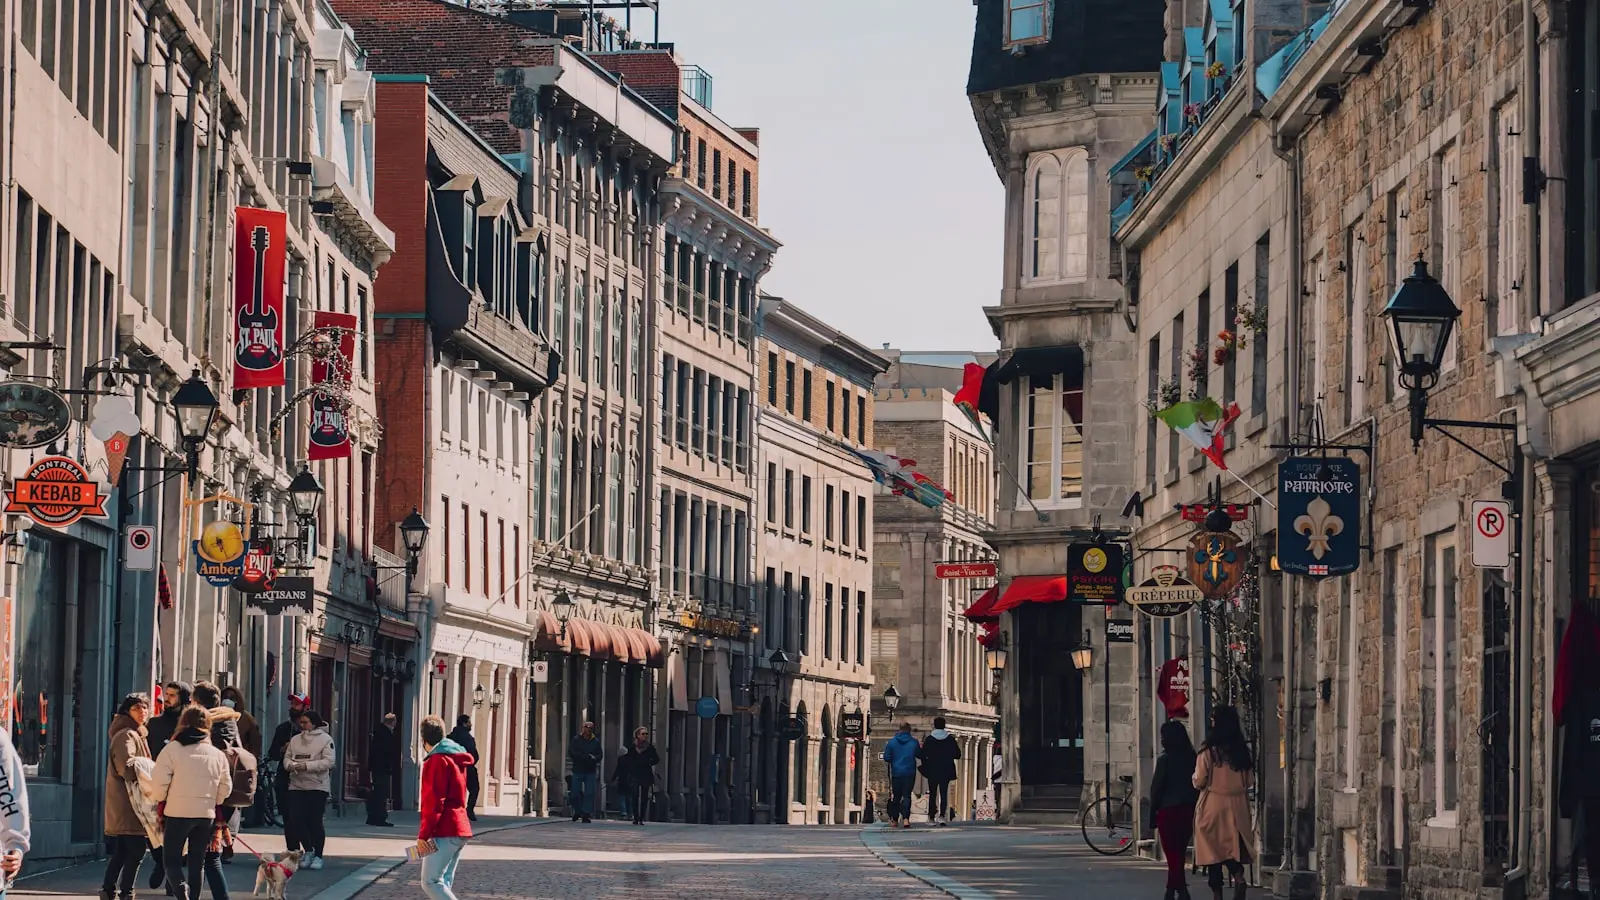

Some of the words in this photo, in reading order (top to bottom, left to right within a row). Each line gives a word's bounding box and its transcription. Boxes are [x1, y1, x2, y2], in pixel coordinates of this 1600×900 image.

[253, 328, 278, 356] PAUL
[31, 460, 82, 480] MONTREAL
[29, 484, 81, 501] KEBAB
[1486, 513, 1497, 531] P
[199, 562, 240, 575] Amber
[250, 554, 272, 580] PAUL
[254, 590, 306, 600] ARTISANS
[1132, 588, 1200, 601] CRÊPERIE
